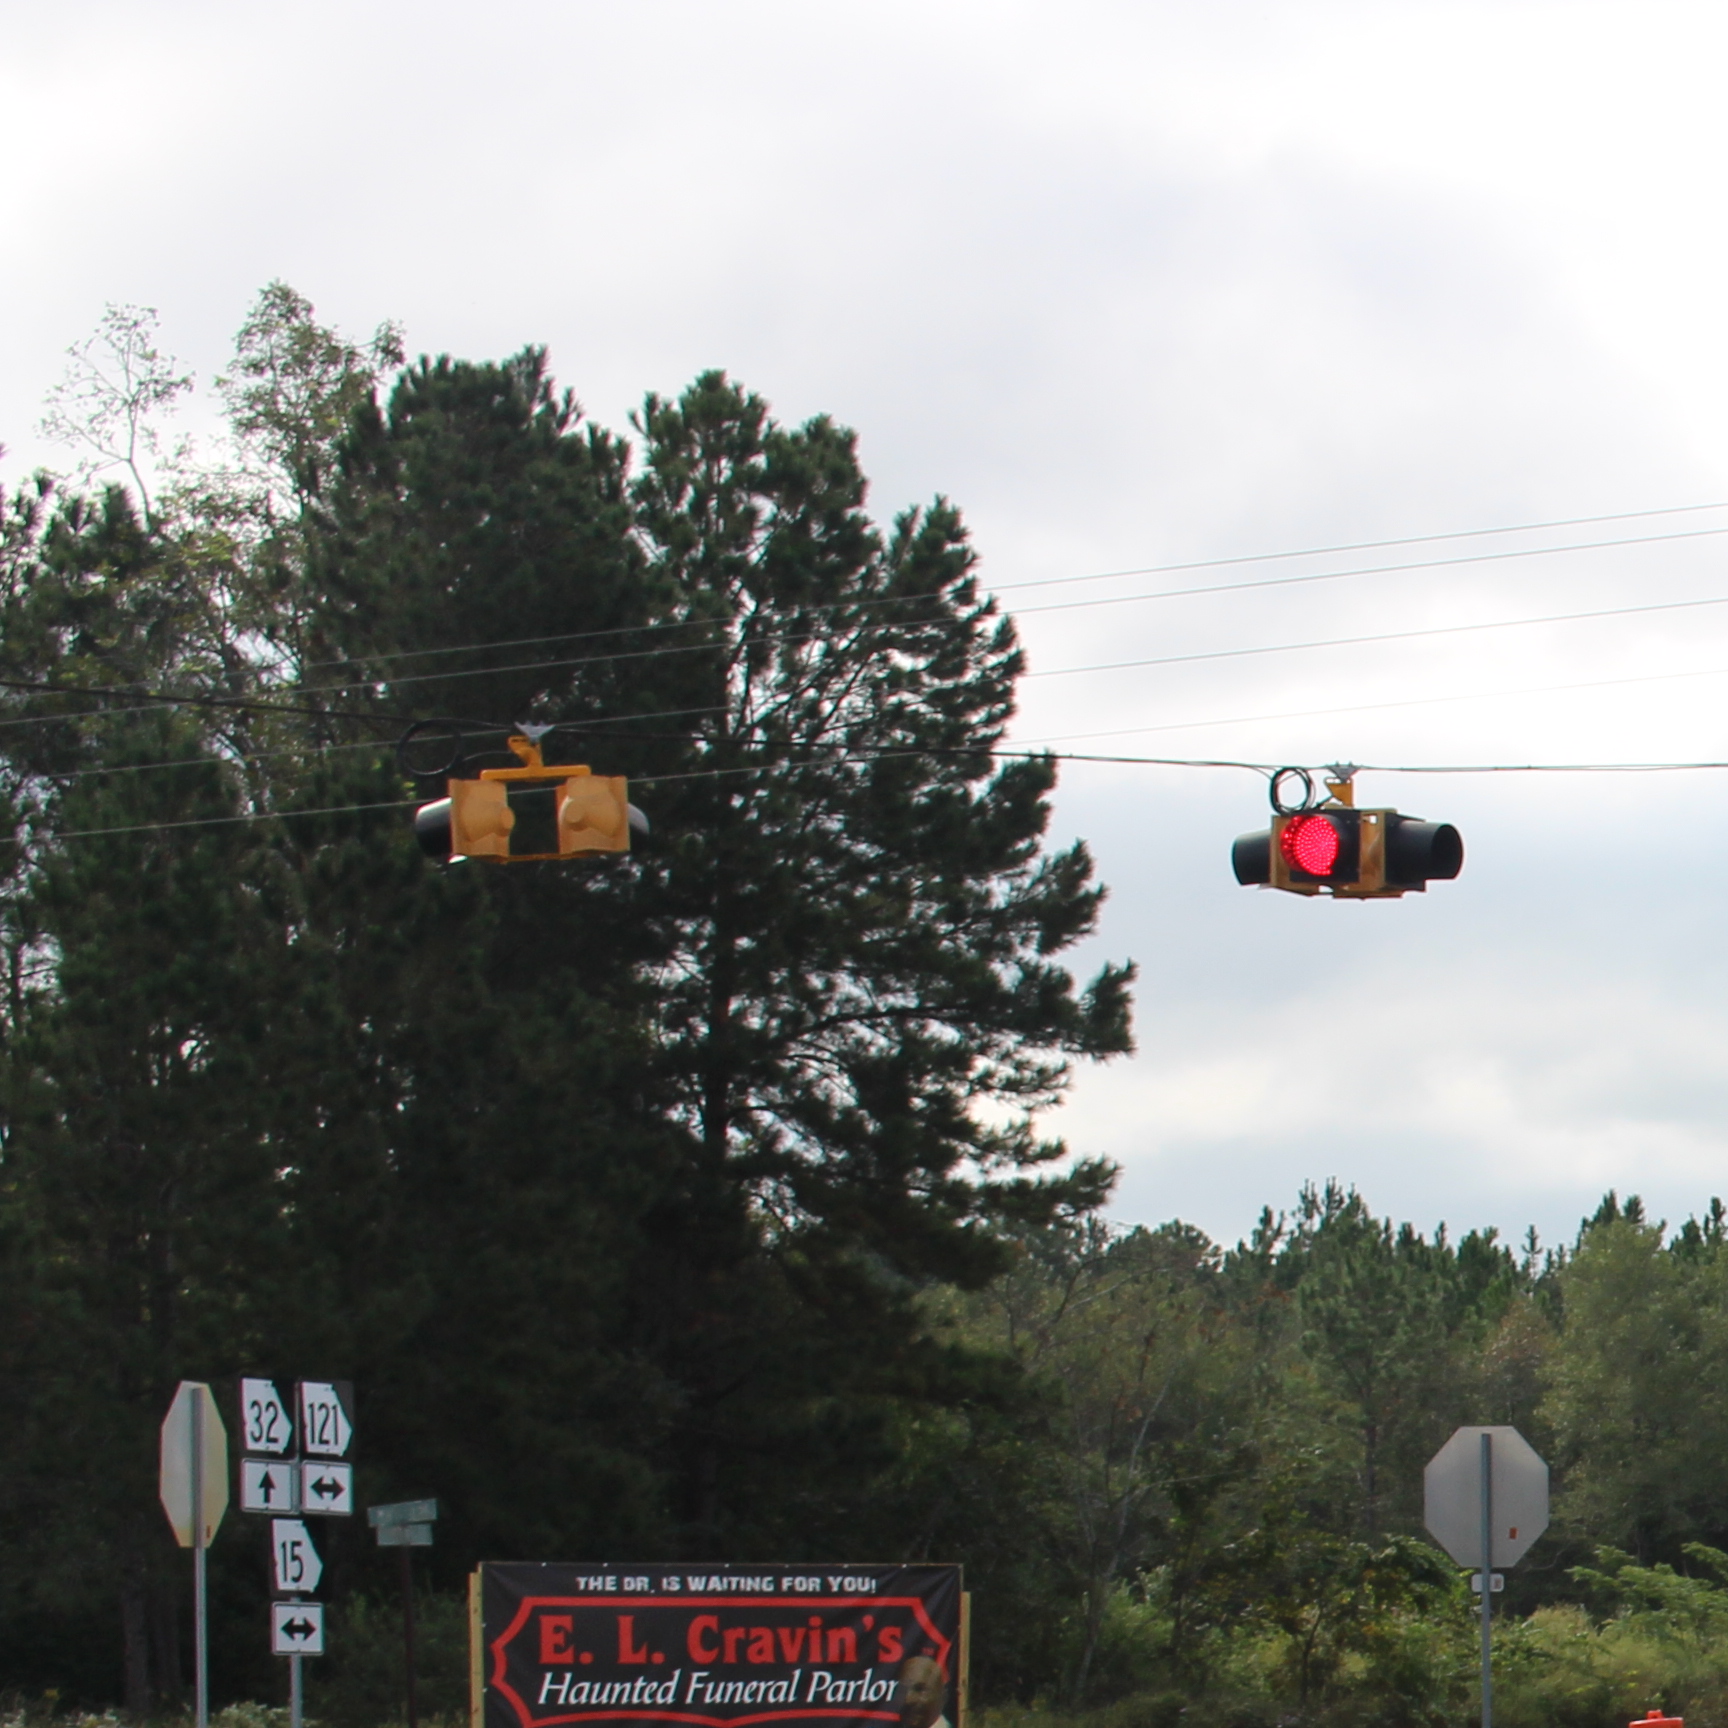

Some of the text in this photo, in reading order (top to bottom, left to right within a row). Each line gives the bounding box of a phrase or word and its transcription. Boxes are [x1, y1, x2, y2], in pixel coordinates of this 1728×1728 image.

[250, 1400, 279, 1443] 32
[308, 1402, 339, 1445] 121
[281, 1540, 304, 1583] 15
[576, 1576, 877, 1594] THE DR. IS WAITING FOR YOU!
[538, 1614, 904, 1665] E. L. Cravin's
[537, 1668, 899, 1705] Haunted Funeral Parlor
